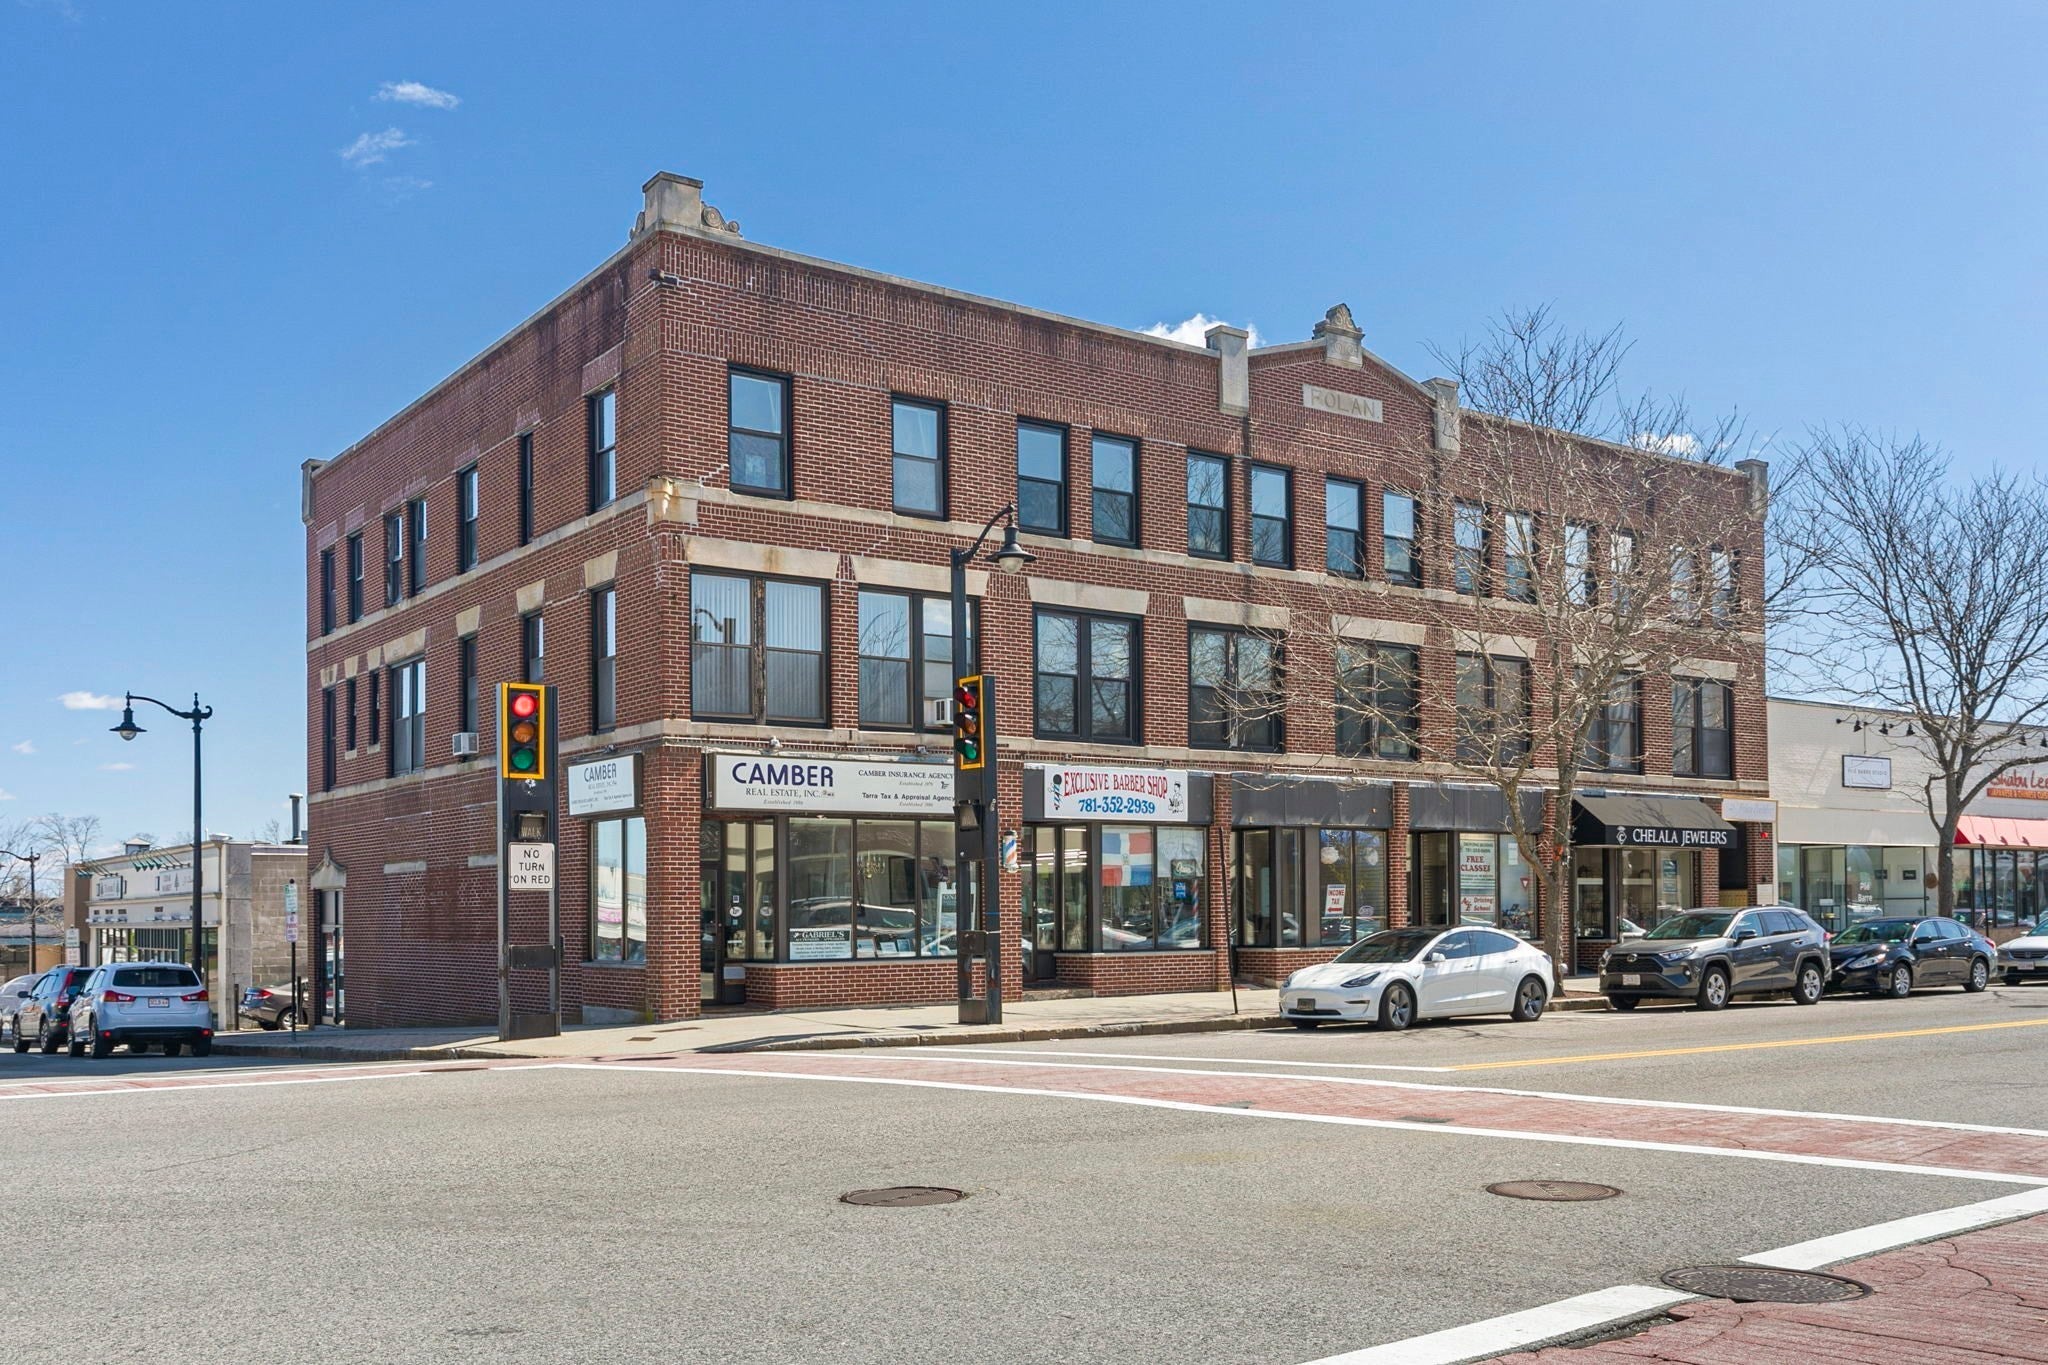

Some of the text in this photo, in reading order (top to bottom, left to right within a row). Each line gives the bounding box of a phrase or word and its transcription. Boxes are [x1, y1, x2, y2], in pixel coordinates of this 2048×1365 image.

[584, 763, 616, 782] CAMBER
[732, 762, 834, 787] CAMBER
[858, 769, 887, 777] CAMBER
[888, 771, 926, 779] INSURANCE
[1064, 772, 1168, 799] EXCLUSIVE BARBER SHOP
[746, 788, 768, 796] REAL
[770, 788, 802, 798] ESTATE,
[804, 789, 821, 798] INC.
[901, 793, 930, 801] Appraisal
[1078, 796, 1155, 814] 781-352-2939
[521, 826, 542, 837] WALK
[1632, 828, 1727, 847] CHELALA JEWELERS
[524, 850, 540, 858] NO
[519, 862, 545, 871] TURN
[513, 875, 550, 884] ON RED
[1857, 893, 1873, 902] Barre
[802, 930, 845, 938] GABRIEL'S
